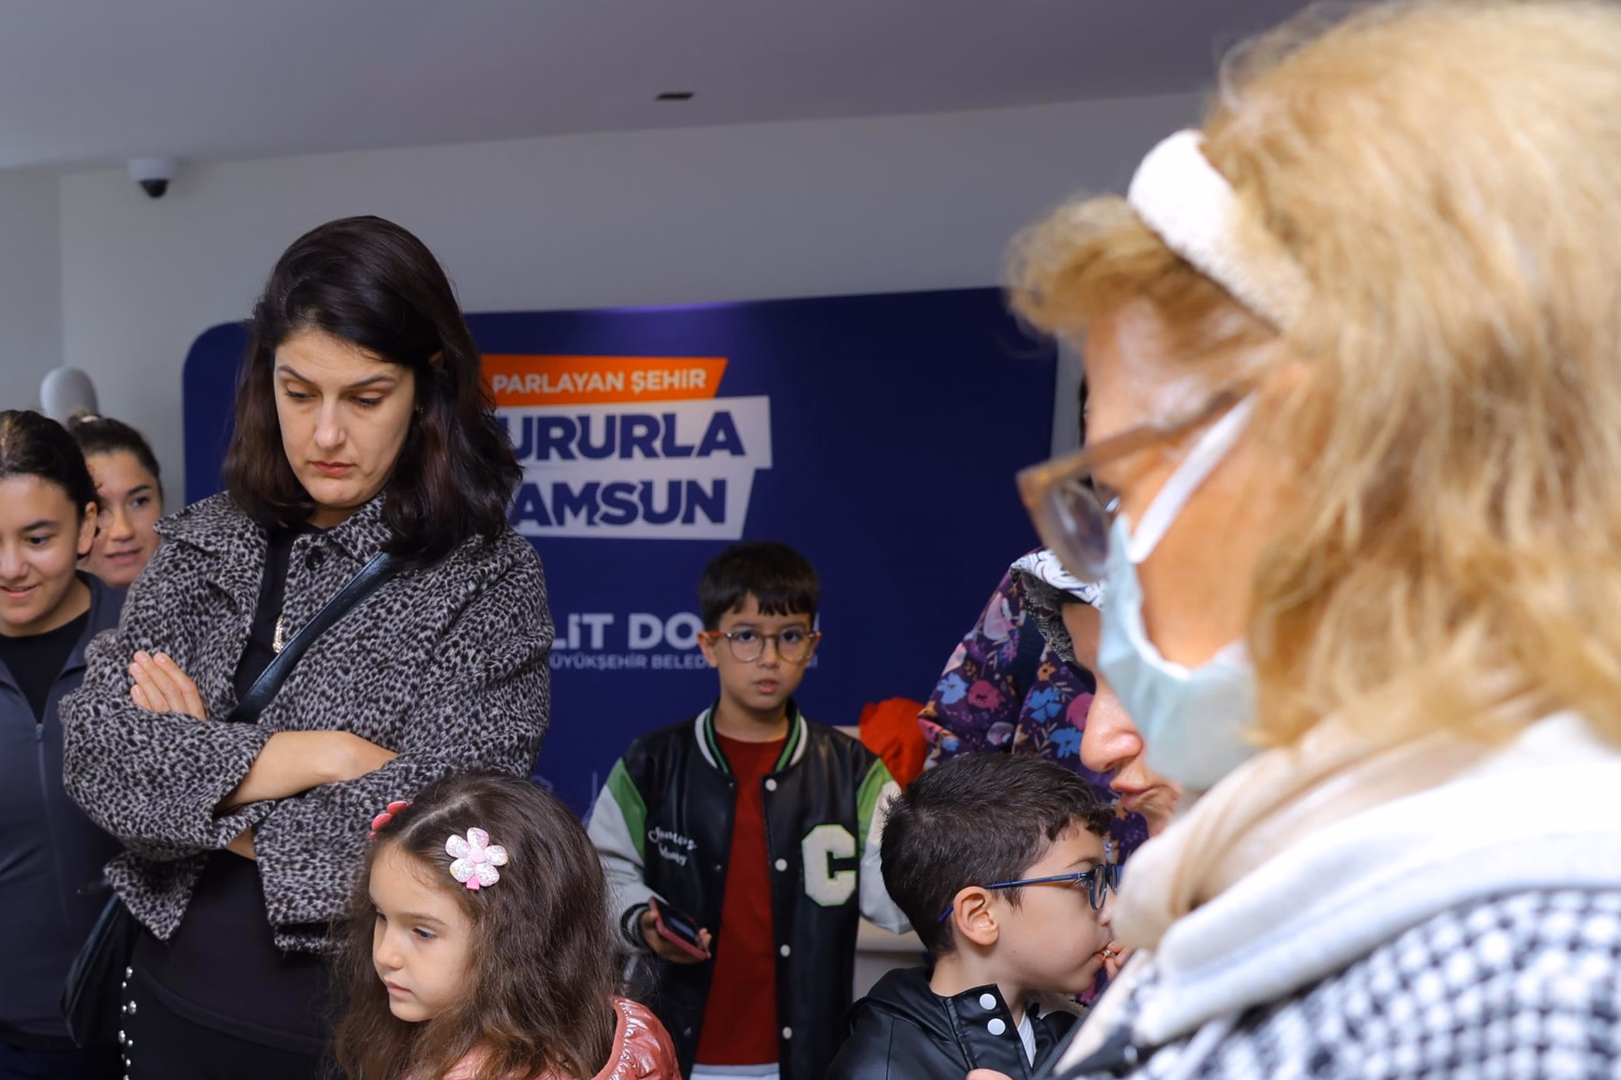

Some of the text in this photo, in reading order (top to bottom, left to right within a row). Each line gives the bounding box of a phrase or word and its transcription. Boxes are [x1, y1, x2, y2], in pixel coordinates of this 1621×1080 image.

[492, 368, 706, 394] PARLAYAN ŞEHİR
[495, 411, 746, 461] URURLA
[508, 478, 727, 527] AMSUN
[628, 611, 705, 650] DO
[549, 652, 712, 671] ÜYÜKŞEHİR BELED
[801, 824, 857, 907] C
